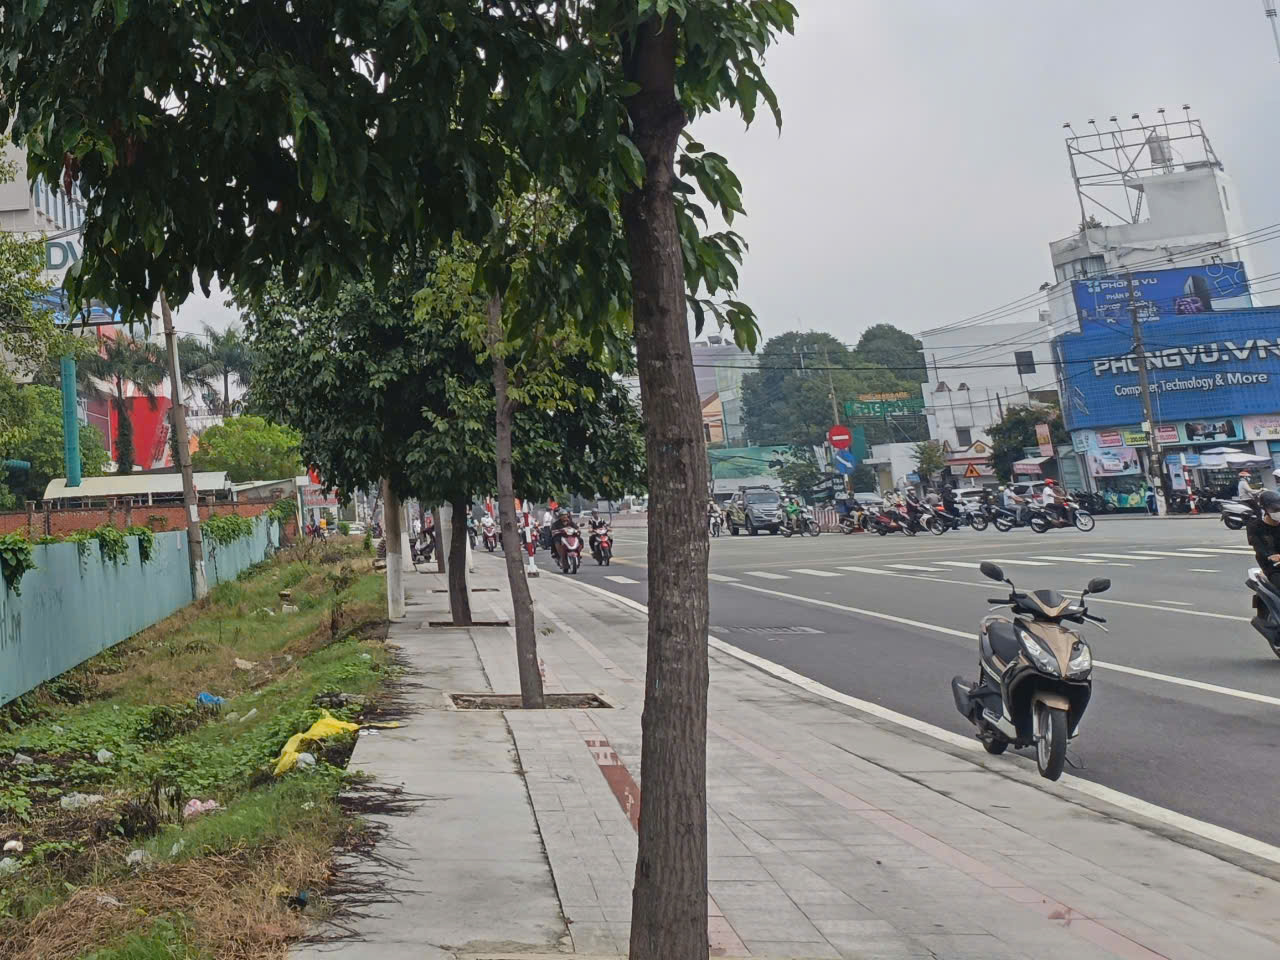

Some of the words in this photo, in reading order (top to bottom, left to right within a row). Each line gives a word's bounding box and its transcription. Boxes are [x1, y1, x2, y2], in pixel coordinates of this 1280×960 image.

[1094, 338, 1280, 376] PHONGVU.VN
[1114, 384, 1161, 397] Comper,
[1161, 376, 1213, 391] Technology
[1215, 373, 1225, 386] &
[1227, 372, 1268, 384] More
